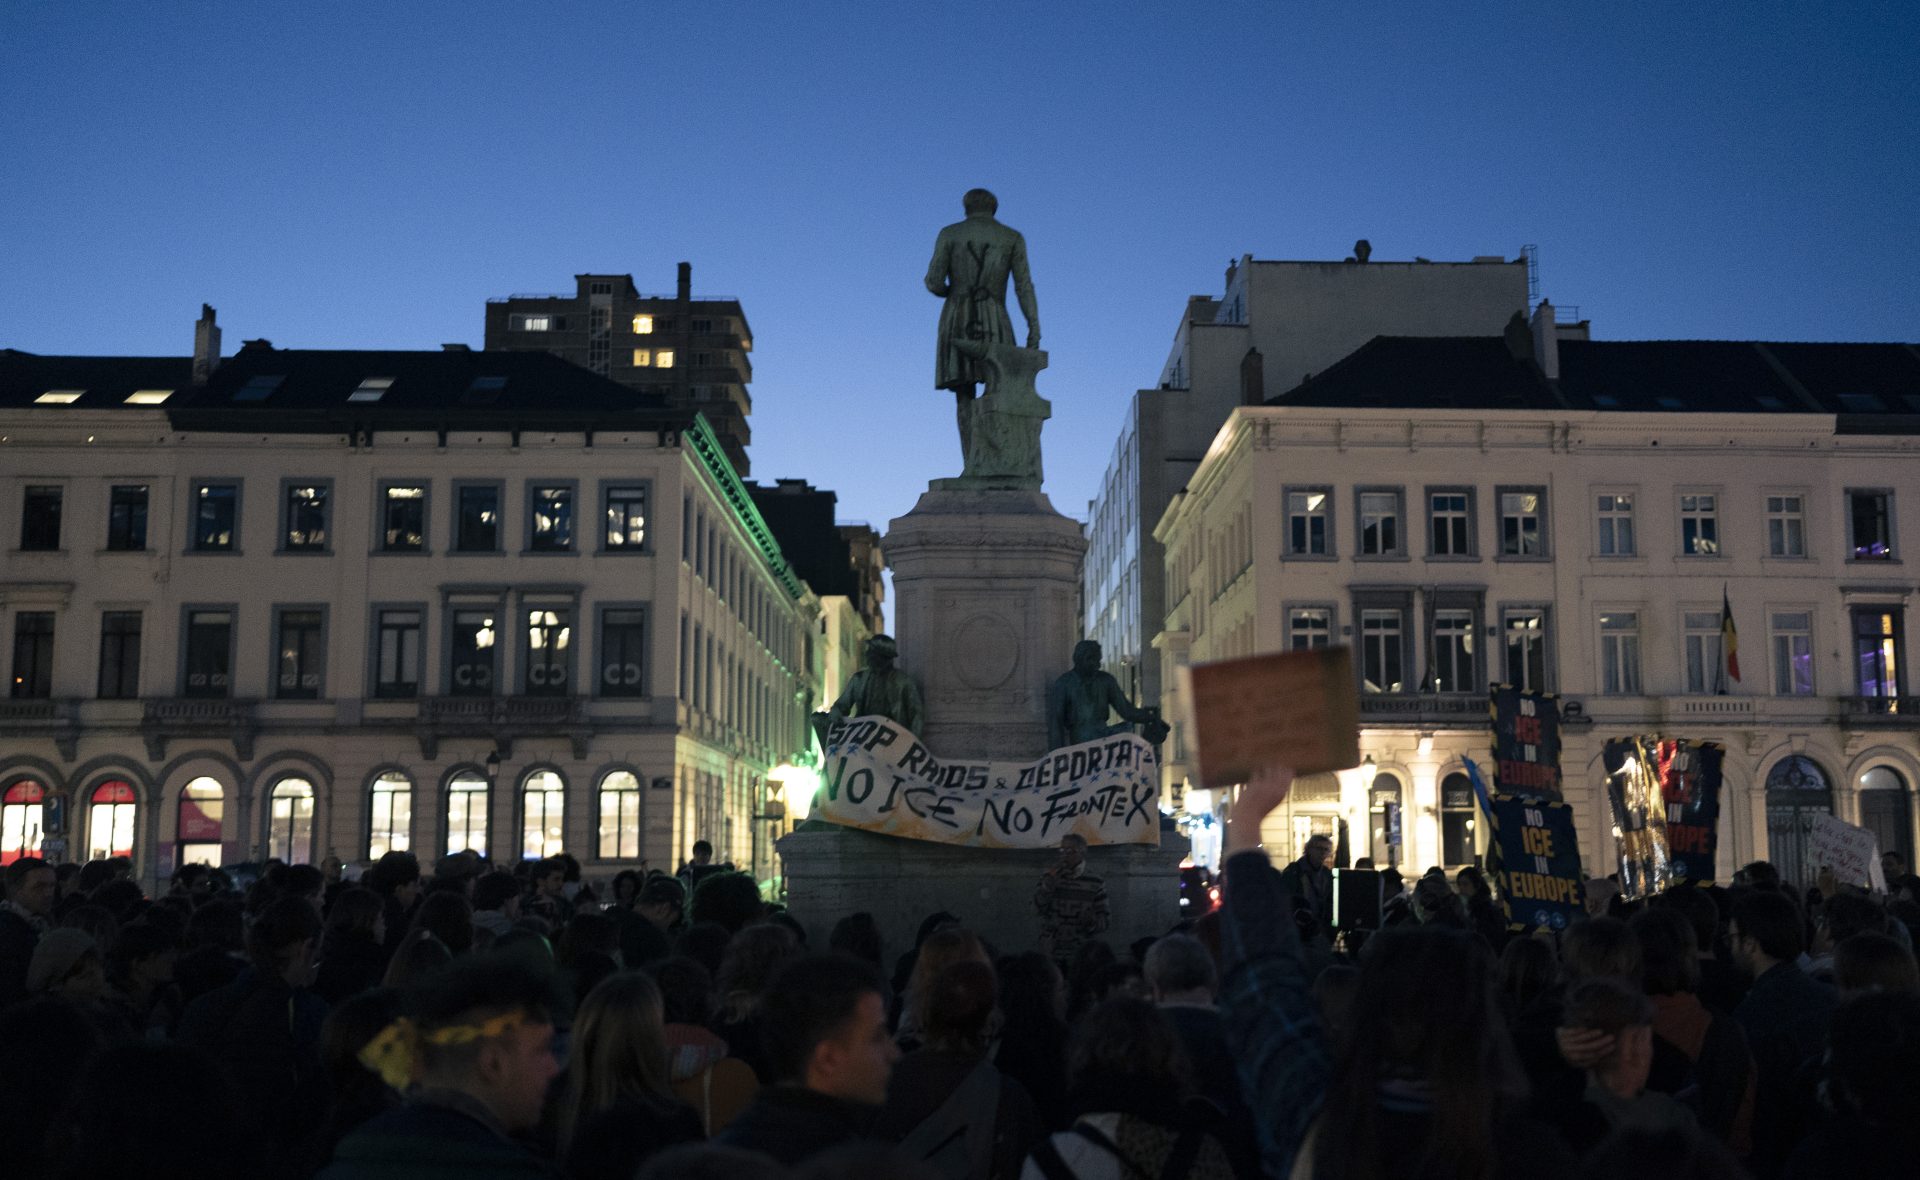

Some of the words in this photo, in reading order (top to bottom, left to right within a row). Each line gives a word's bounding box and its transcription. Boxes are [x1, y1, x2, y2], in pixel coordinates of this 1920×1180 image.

[1520, 698, 1536, 717] NO
[1515, 715, 1542, 745] ICE
[829, 721, 898, 751] STOP
[898, 742, 990, 790] RAIDS
[994, 777, 1007, 789] &
[1524, 744, 1536, 763] IN
[1499, 759, 1557, 791] EUROPE
[878, 775, 964, 828] ICE
[976, 799, 1033, 836] NO
[1524, 808, 1544, 827] NO
[1521, 826, 1556, 858] ICE
[1535, 856, 1549, 874] IN
[1510, 871, 1581, 906] EUROPE
